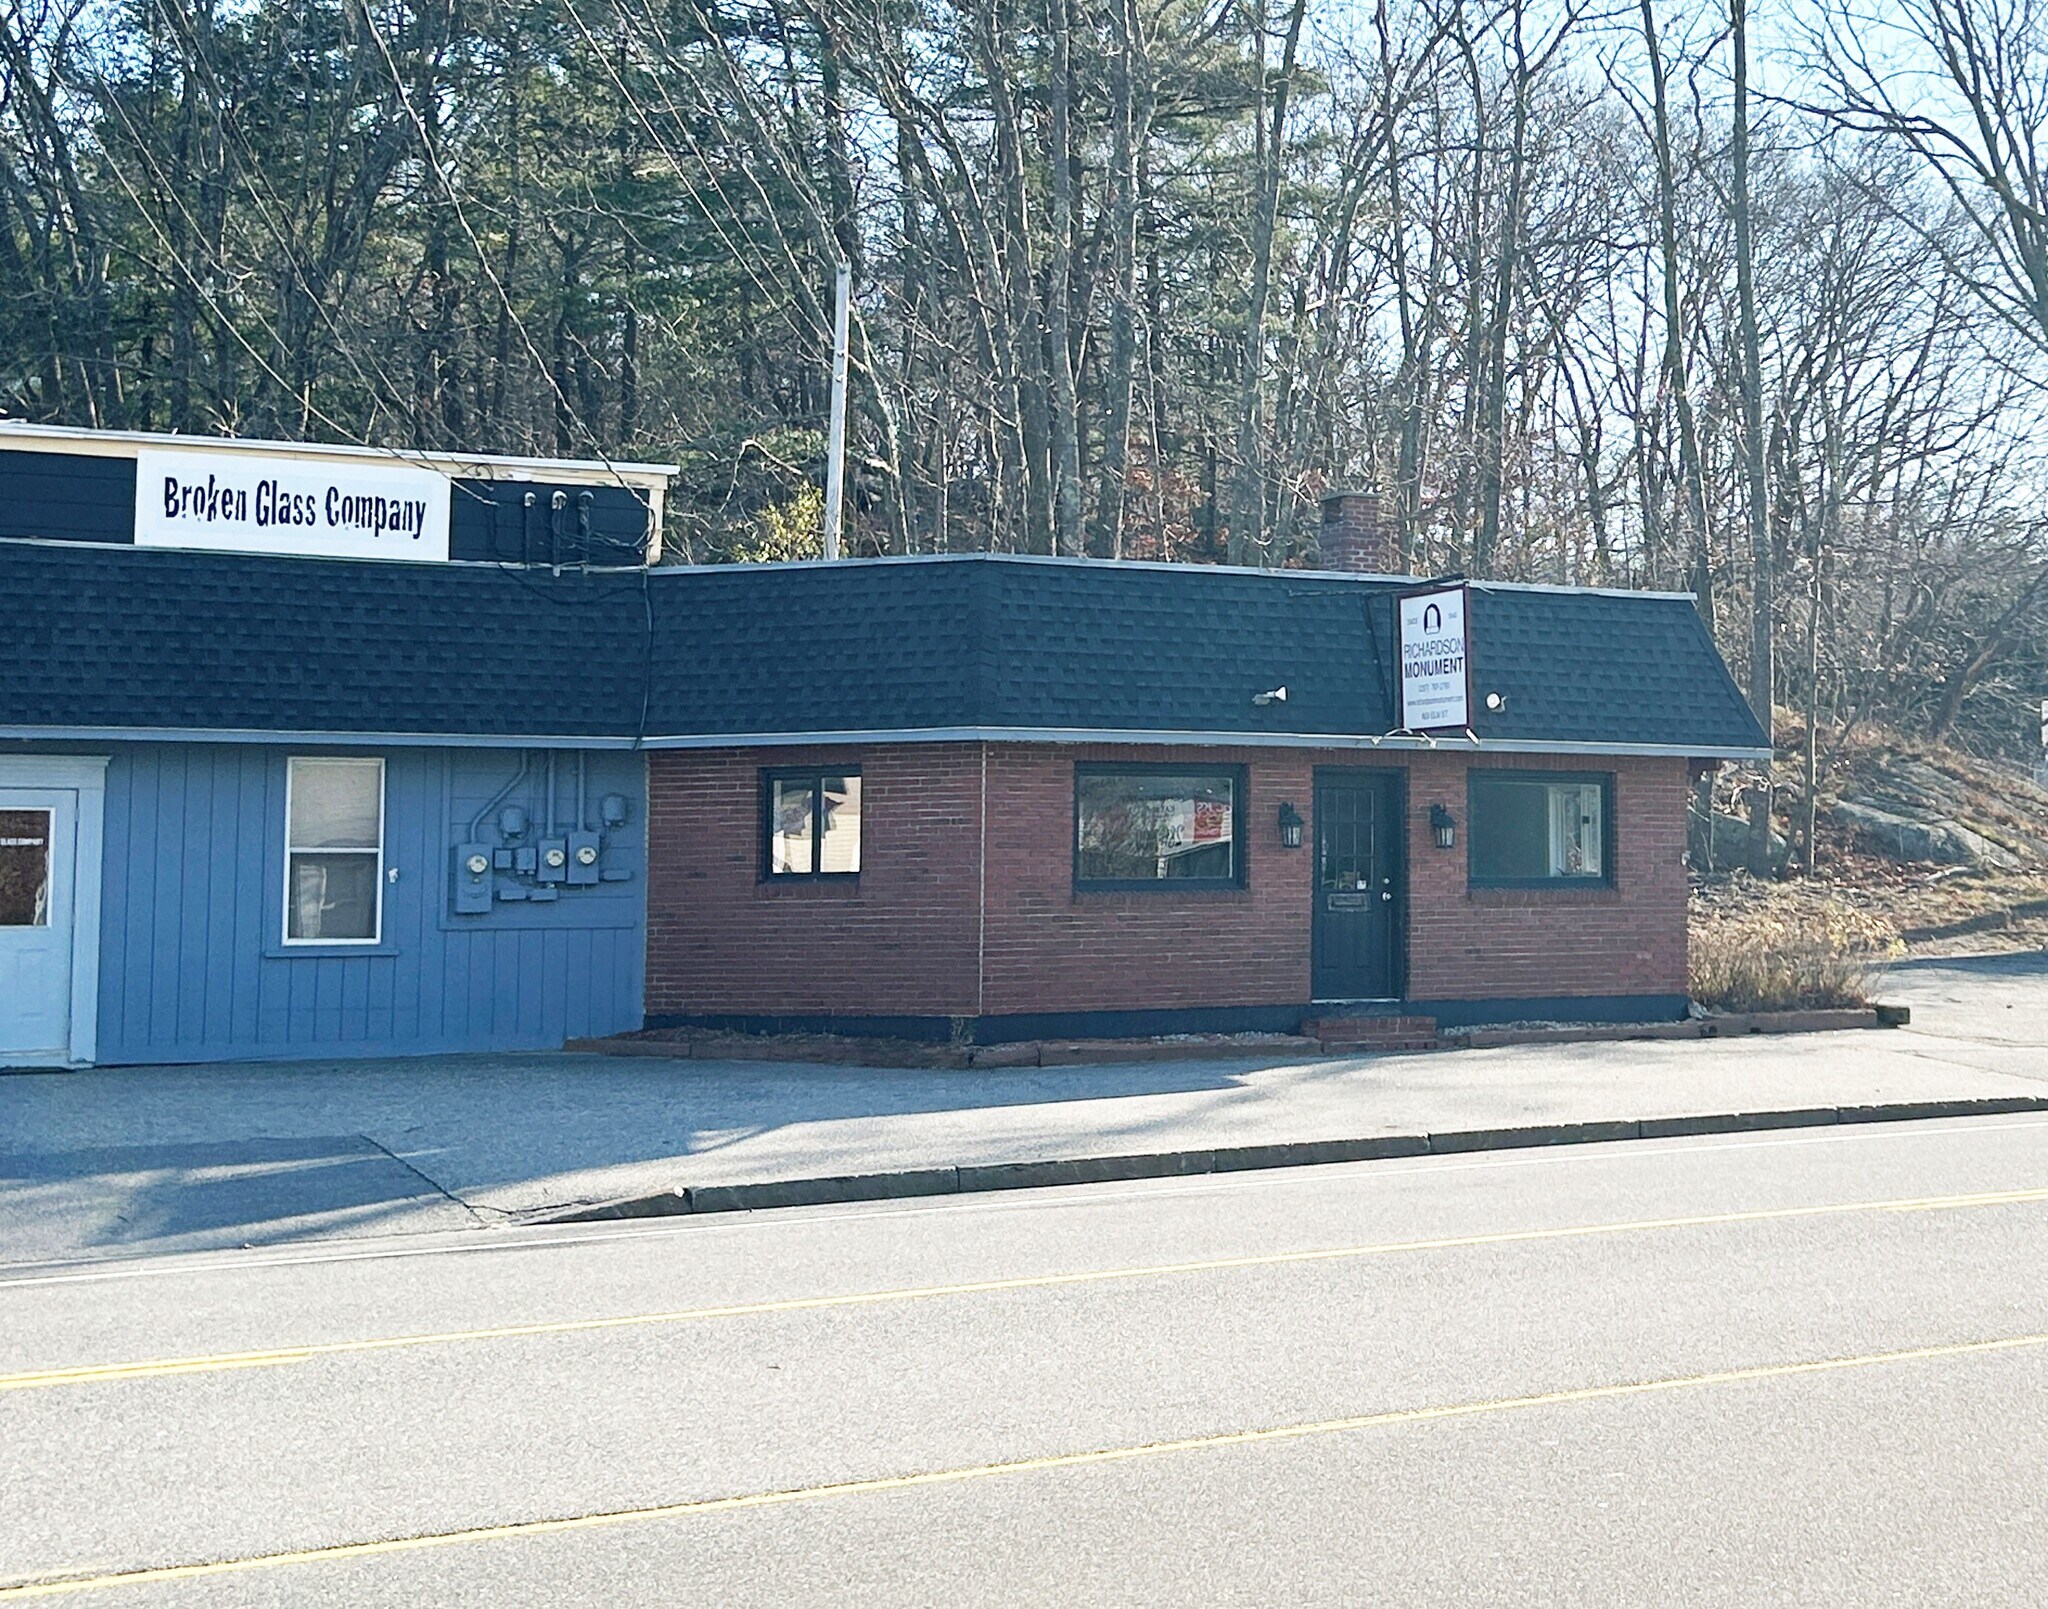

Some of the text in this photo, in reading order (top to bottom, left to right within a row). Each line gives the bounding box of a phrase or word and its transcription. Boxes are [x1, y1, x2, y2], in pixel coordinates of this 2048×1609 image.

[164, 474, 427, 539] Broken Glass Company
[1404, 637, 1464, 659] RICHARDSON
[1405, 656, 1463, 678] MONUMENT
